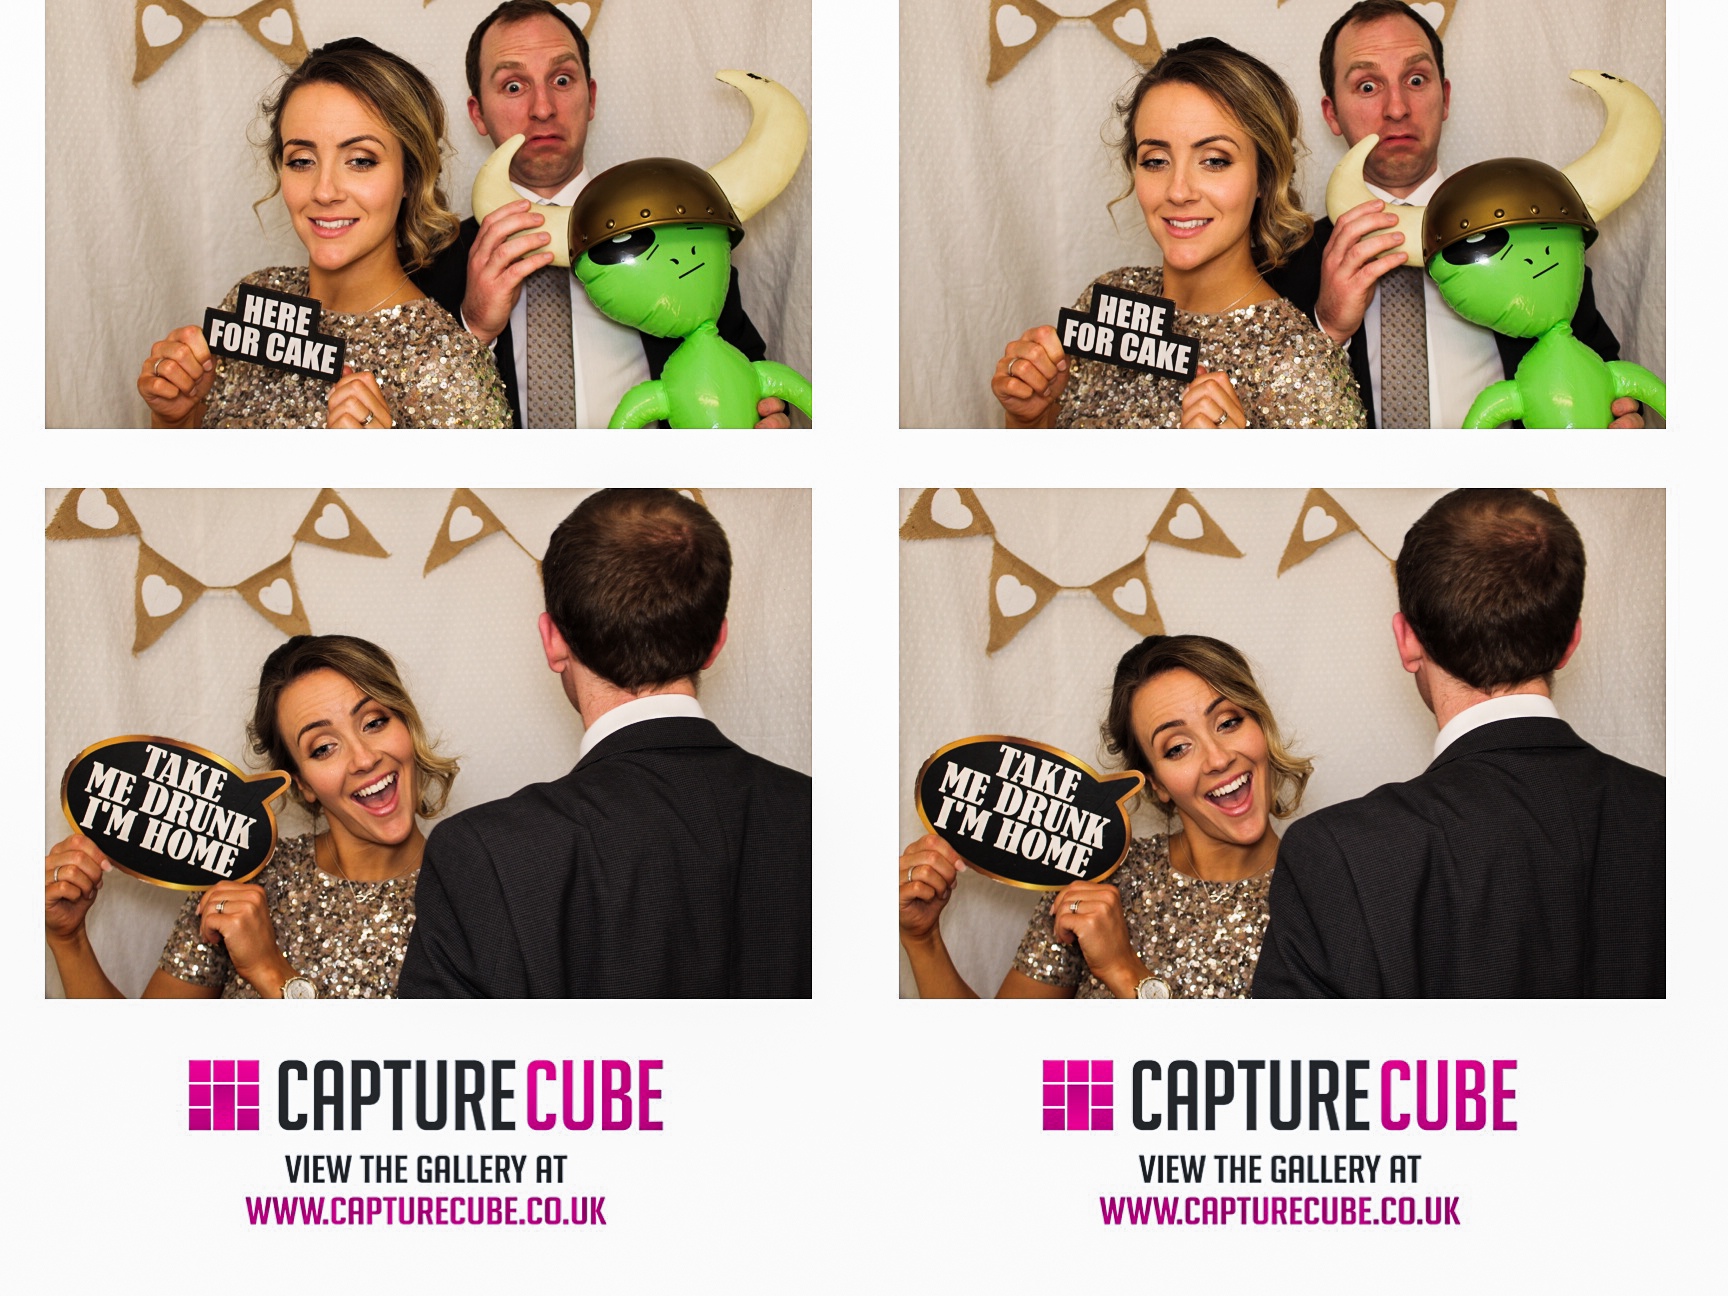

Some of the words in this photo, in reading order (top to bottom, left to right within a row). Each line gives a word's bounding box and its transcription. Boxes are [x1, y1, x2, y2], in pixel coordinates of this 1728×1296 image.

[242, 294, 312, 336] HERE
[1096, 294, 1166, 336] HERE
[209, 318, 261, 357] FOR
[265, 332, 338, 375] CAKE
[1063, 318, 1115, 357] FOR
[1119, 332, 1192, 375] CAKE
[141, 744, 228, 803] TAKE
[995, 744, 1082, 803] TAKE
[84, 761, 137, 806] ME
[138, 780, 257, 850] DRUNK
[938, 761, 991, 806] ME
[992, 780, 1111, 850] DRUNK
[79, 795, 139, 842] I'M
[139, 817, 239, 878] HOME
[933, 795, 993, 842] I'M
[993, 817, 1093, 878] HOME
